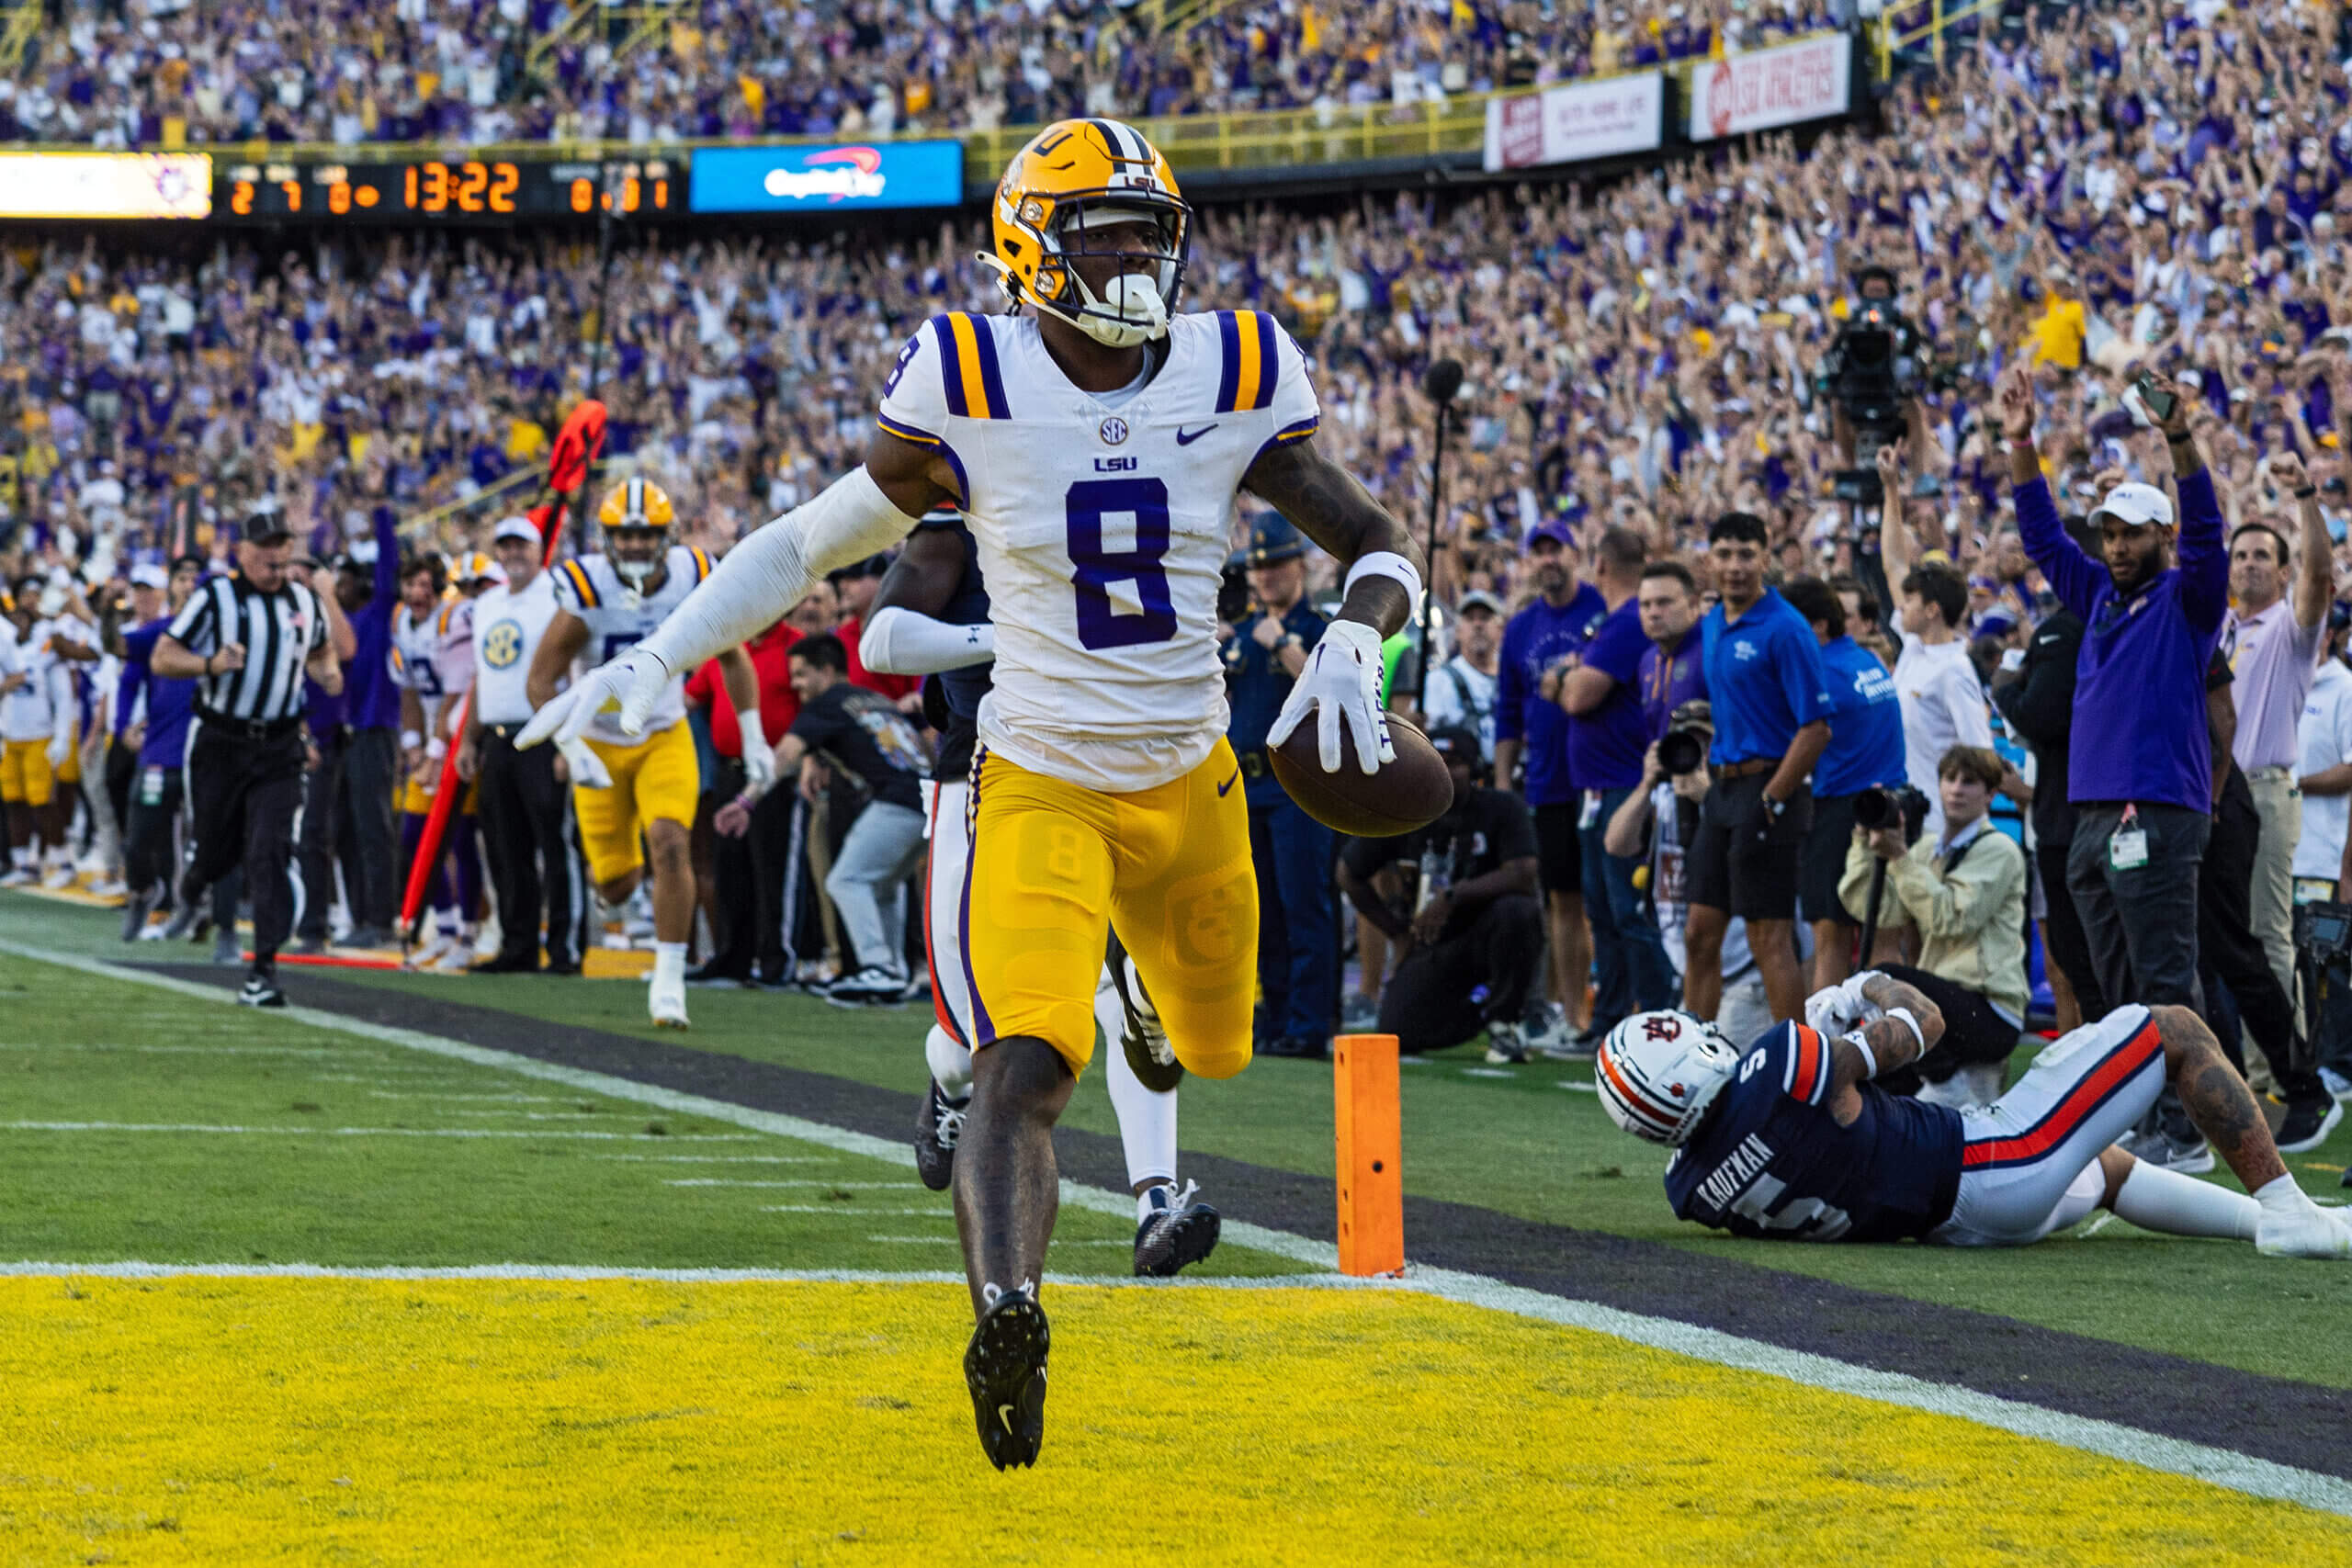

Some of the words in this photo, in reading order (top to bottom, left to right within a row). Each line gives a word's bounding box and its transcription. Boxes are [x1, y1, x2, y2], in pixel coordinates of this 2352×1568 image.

[404, 162, 519, 212] 13:22
[883, 334, 920, 399] 8
[1102, 418, 1127, 444] SEC
[1094, 457, 1137, 471] LSU
[1066, 477, 1178, 650] 8
[1696, 1132, 1776, 1213] KAUFMAN
